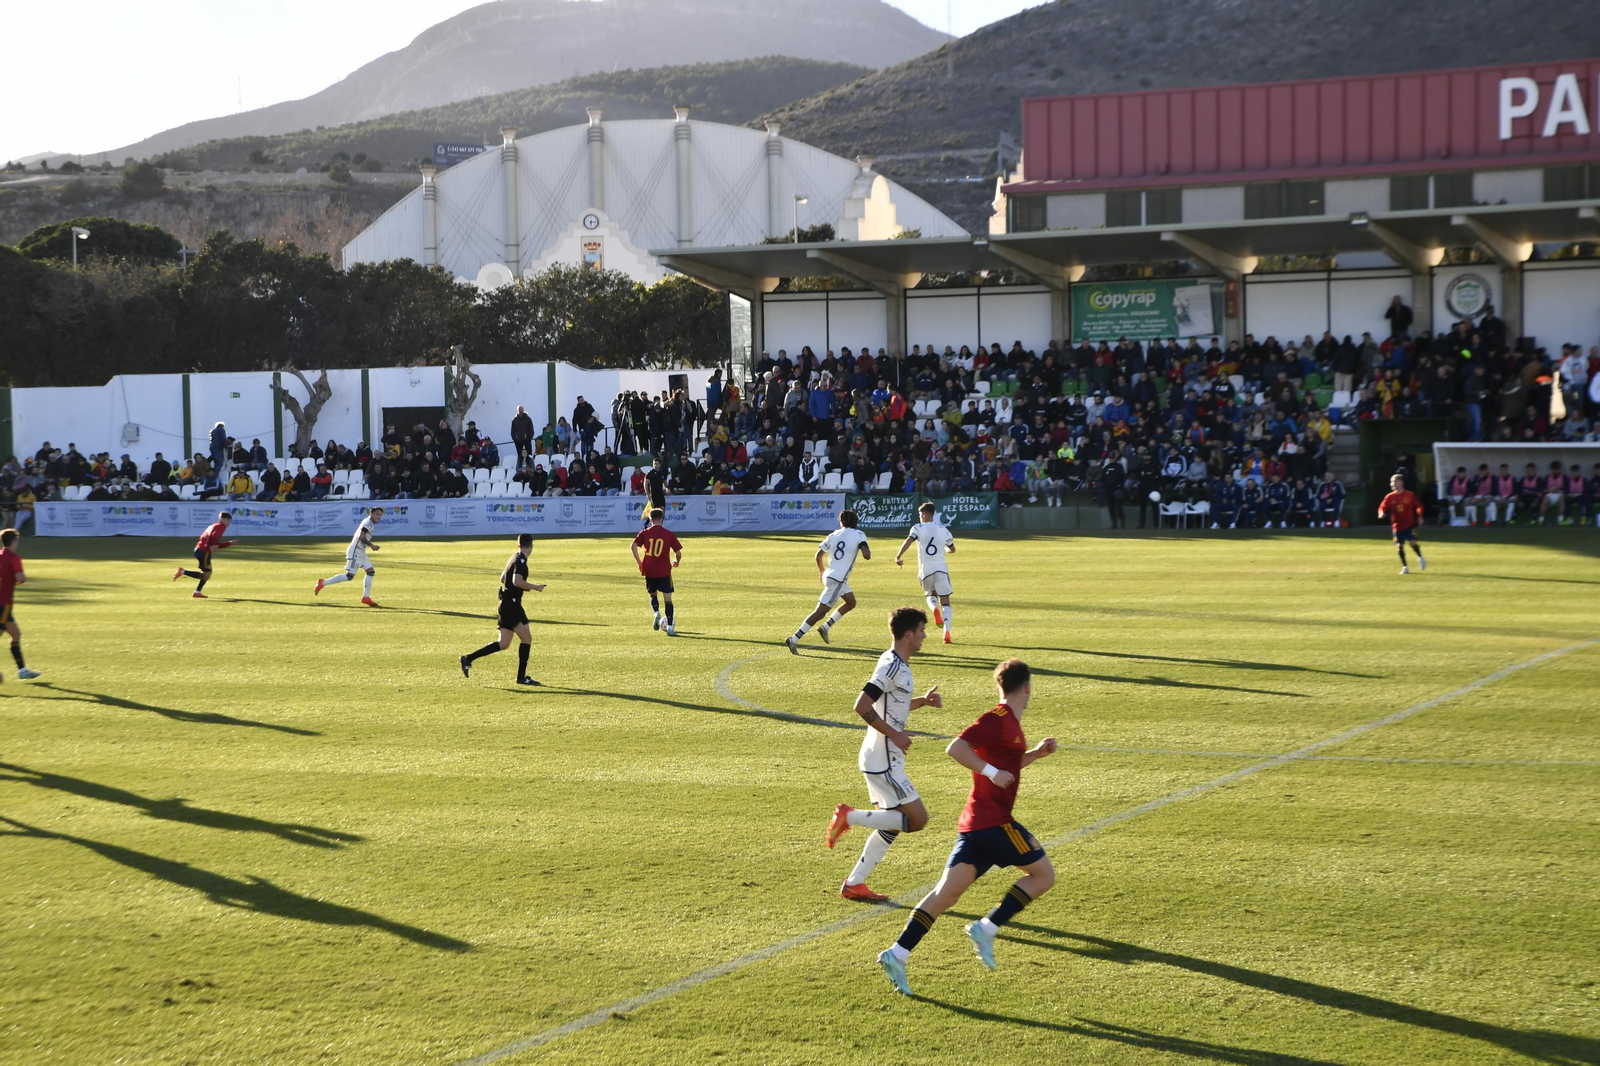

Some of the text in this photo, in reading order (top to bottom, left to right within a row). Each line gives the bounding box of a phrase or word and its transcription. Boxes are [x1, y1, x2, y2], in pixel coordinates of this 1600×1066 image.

[1499, 73, 1600, 140] PA
[646, 538, 664, 557] 10
[834, 541, 846, 560] 8
[926, 537, 937, 556] 6
